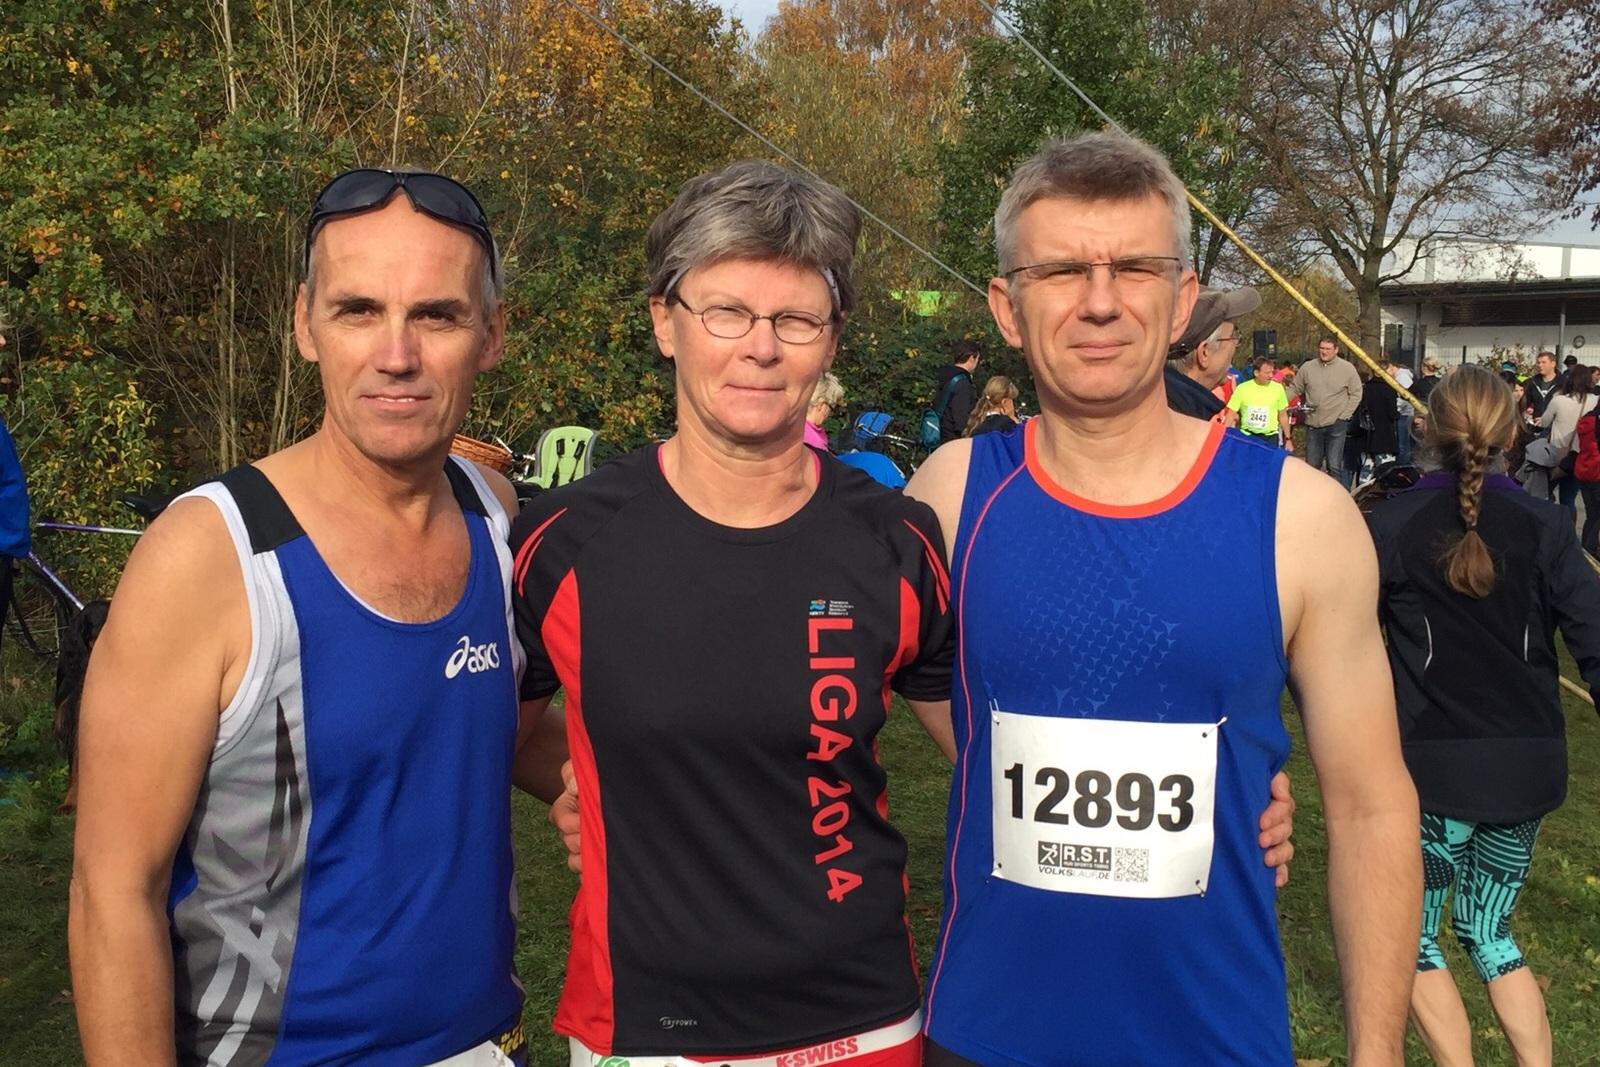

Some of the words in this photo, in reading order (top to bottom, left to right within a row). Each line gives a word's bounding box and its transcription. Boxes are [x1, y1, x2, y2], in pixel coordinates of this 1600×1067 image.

[1250, 413, 1267, 422] 2442
[806, 618, 858, 761] LIGA
[1004, 763, 1195, 832] 12893
[807, 776, 863, 902] 2014
[776, 1037, 858, 1067] K-SWISS
